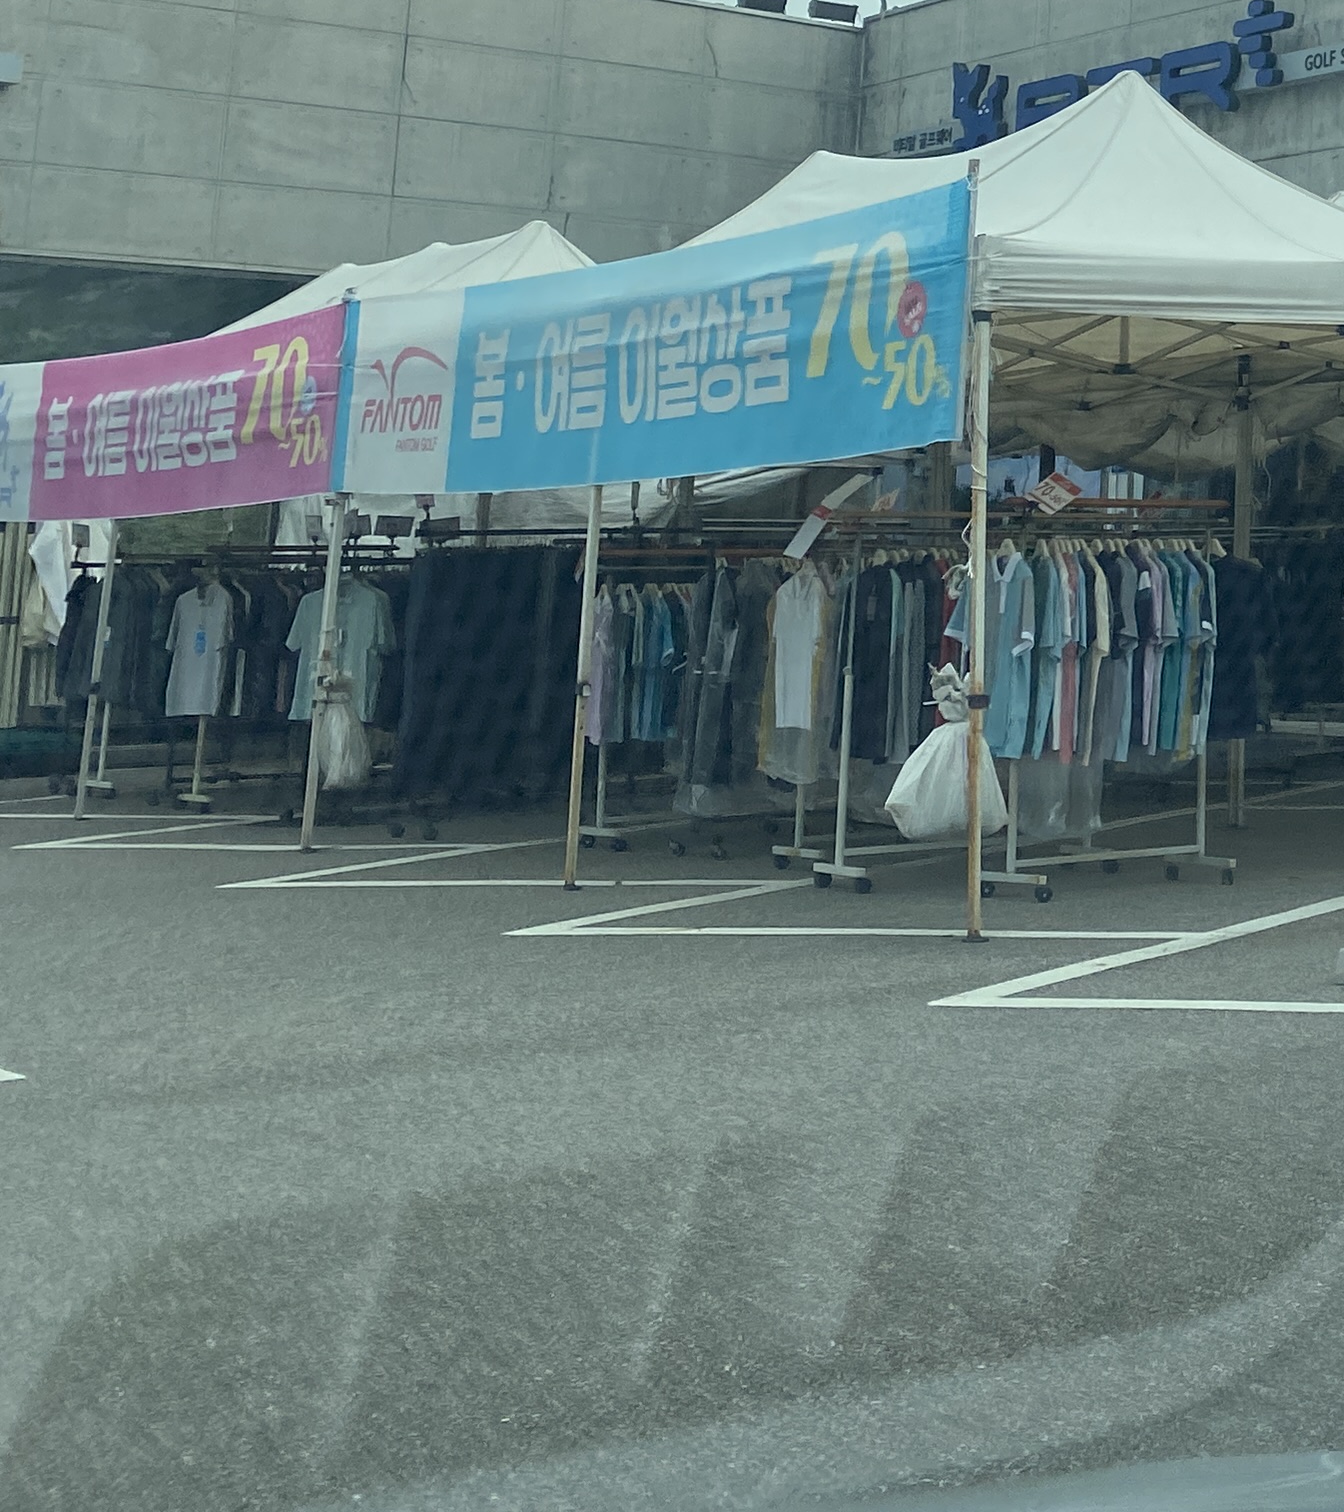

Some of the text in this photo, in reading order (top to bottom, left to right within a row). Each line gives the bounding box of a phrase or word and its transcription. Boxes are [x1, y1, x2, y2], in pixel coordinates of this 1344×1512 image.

[1304, 49, 1337, 71] GOLF
[619, 276, 792, 425] 이월상품
[806, 231, 910, 378] 70
[132, 369, 246, 473] 이월상품
[240, 336, 309, 446] 70
[360, 394, 443, 434] FANTOM
